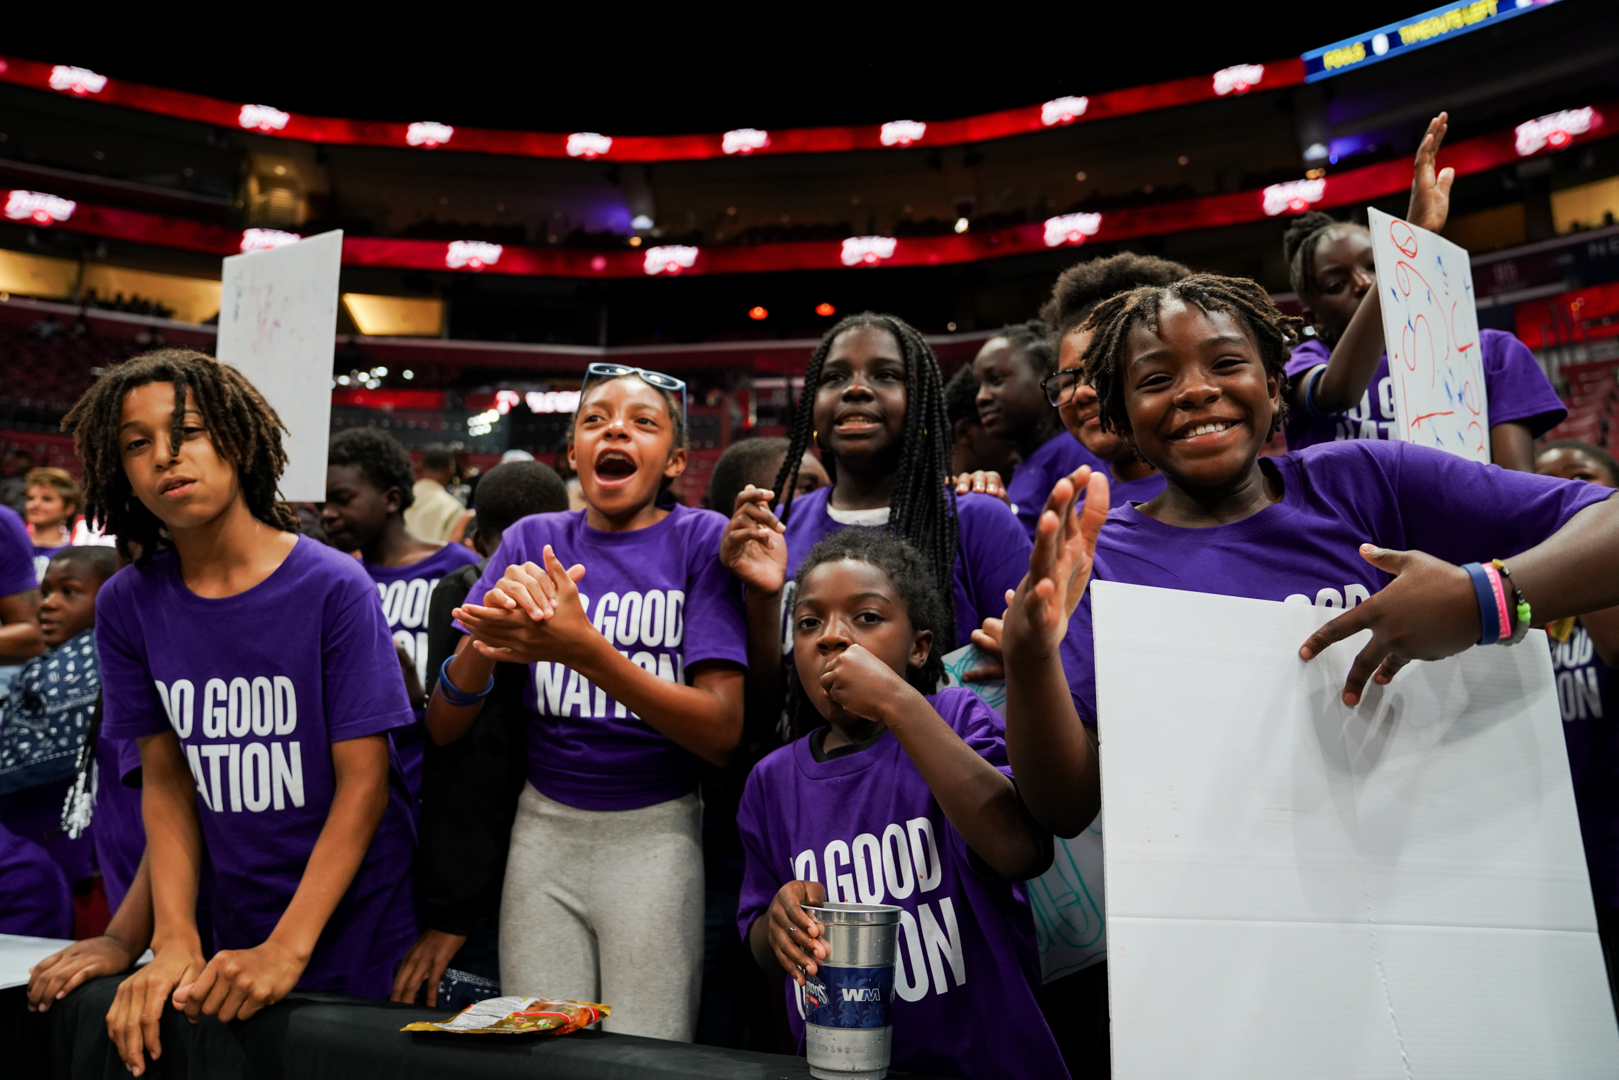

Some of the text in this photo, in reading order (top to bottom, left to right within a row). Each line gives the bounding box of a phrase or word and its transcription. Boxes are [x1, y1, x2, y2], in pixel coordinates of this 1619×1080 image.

[1323, 42, 1366, 70] FOULS
[1398, 8, 1464, 46] TIMEOUTS
[593, 589, 685, 648] GOOD
[202, 675, 298, 739] GOOD
[180, 741, 305, 813] ATION
[824, 816, 942, 905] GOOD
[842, 988, 880, 1002] WM
